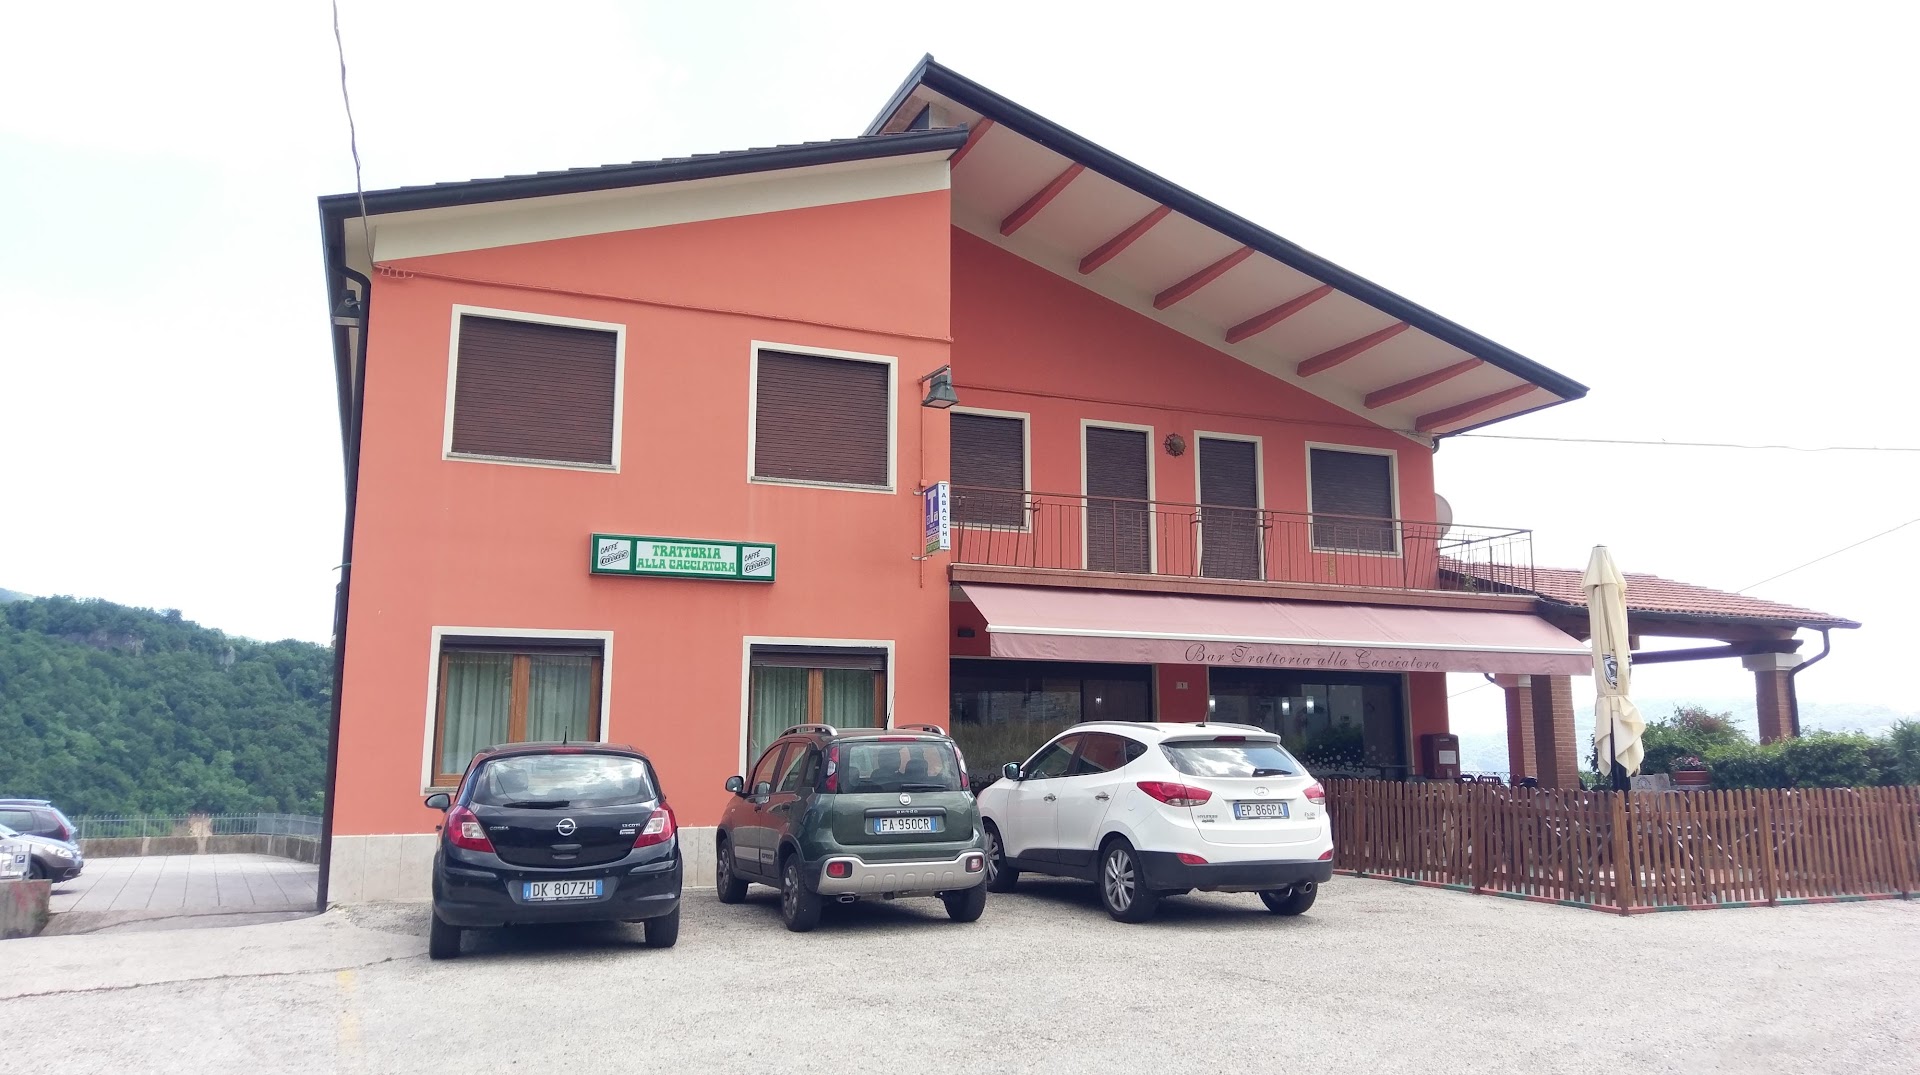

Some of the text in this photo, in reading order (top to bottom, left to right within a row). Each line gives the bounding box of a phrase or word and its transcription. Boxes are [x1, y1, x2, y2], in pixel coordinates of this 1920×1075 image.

[652, 545, 721, 559] TRATTORIA
[637, 558, 736, 572] ALLA CACCIATORA
[1185, 643, 1440, 669] Bar Trattoria alla Cacciatora
[1241, 804, 1283, 816] EP 866PA
[882, 818, 930, 831] FA 950CR
[533, 881, 595, 897] DK 807ZH
